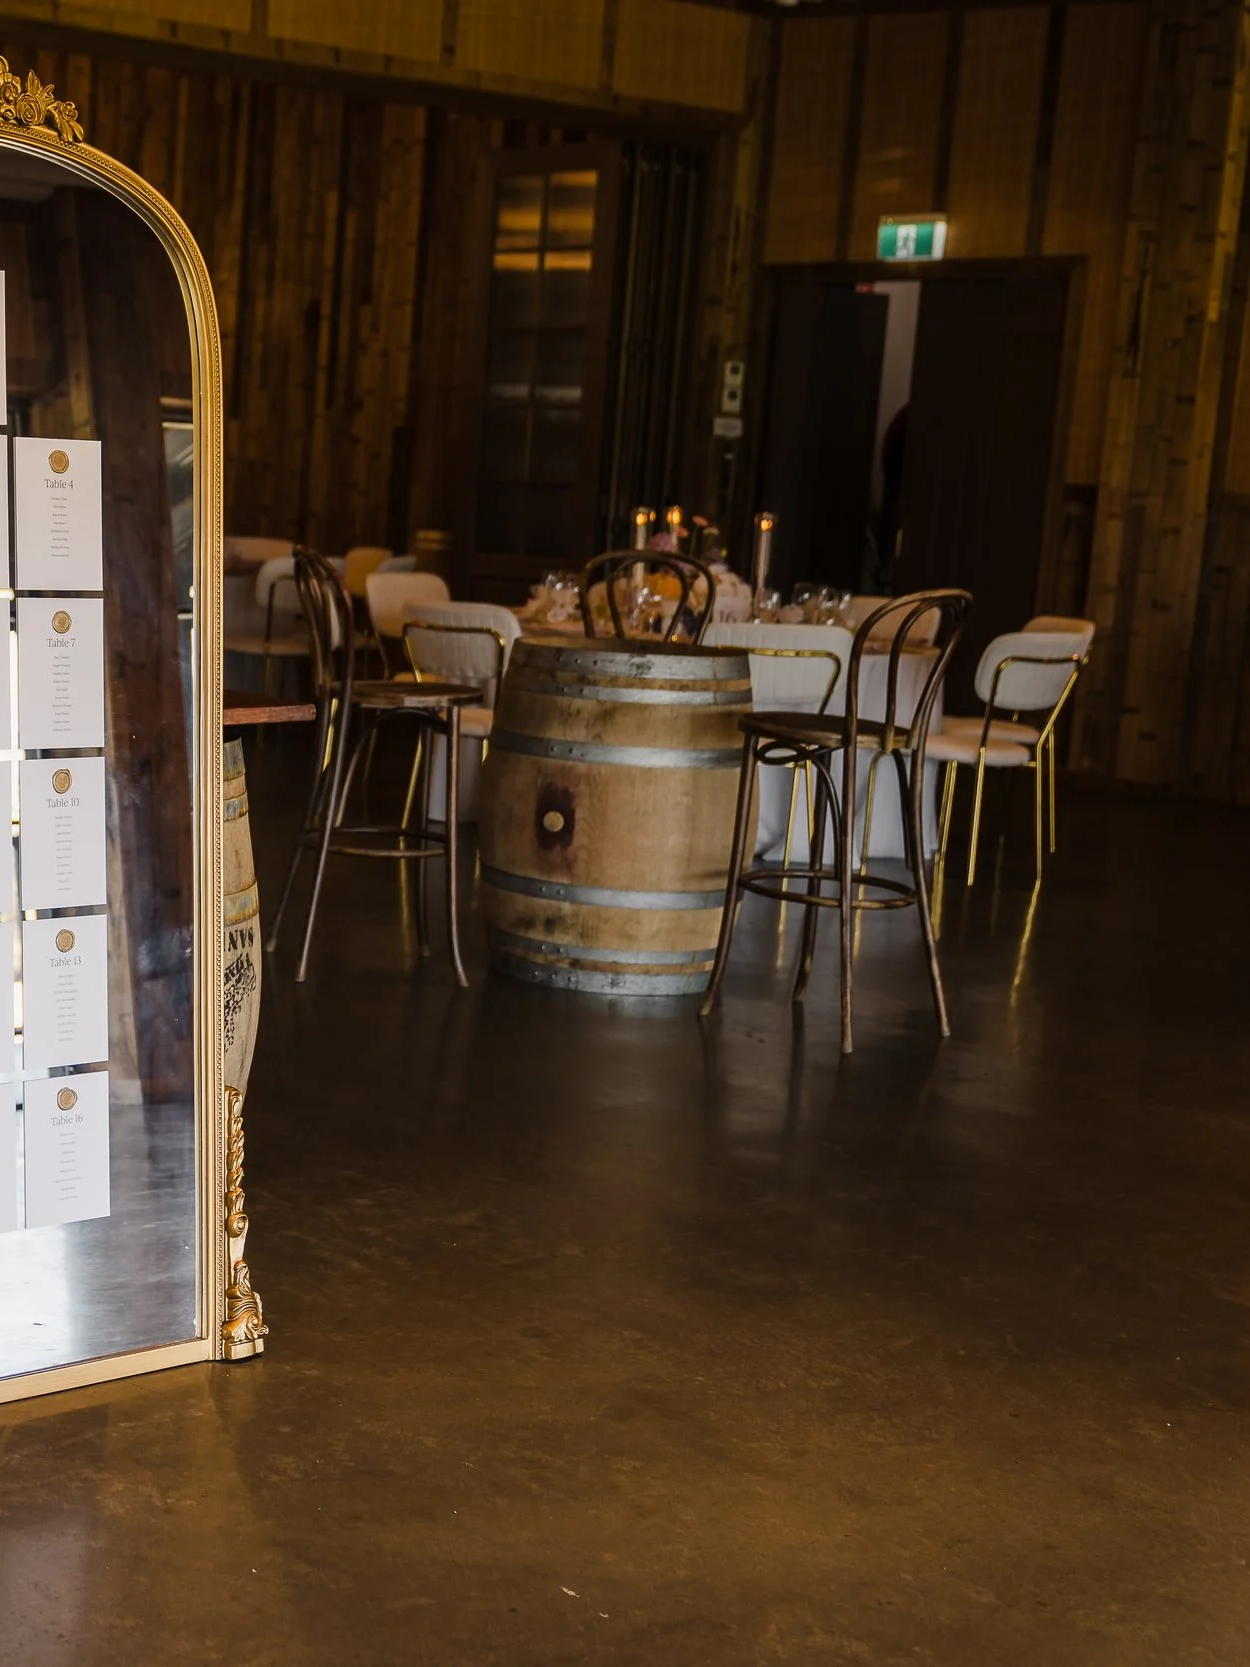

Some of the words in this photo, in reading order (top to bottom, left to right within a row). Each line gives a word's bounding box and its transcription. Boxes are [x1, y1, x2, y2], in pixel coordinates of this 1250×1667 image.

[45, 479, 66, 488] Table
[69, 480, 74, 489] 4
[47, 638, 69, 647] Table
[71, 638, 76, 647] 7
[46, 798, 68, 808] Table
[71, 797, 79, 806] 10
[50, 957, 71, 967] Table
[74, 956, 81, 965] 13
[51, 1116, 73, 1127] Table
[75, 1114, 83, 1123] 16
